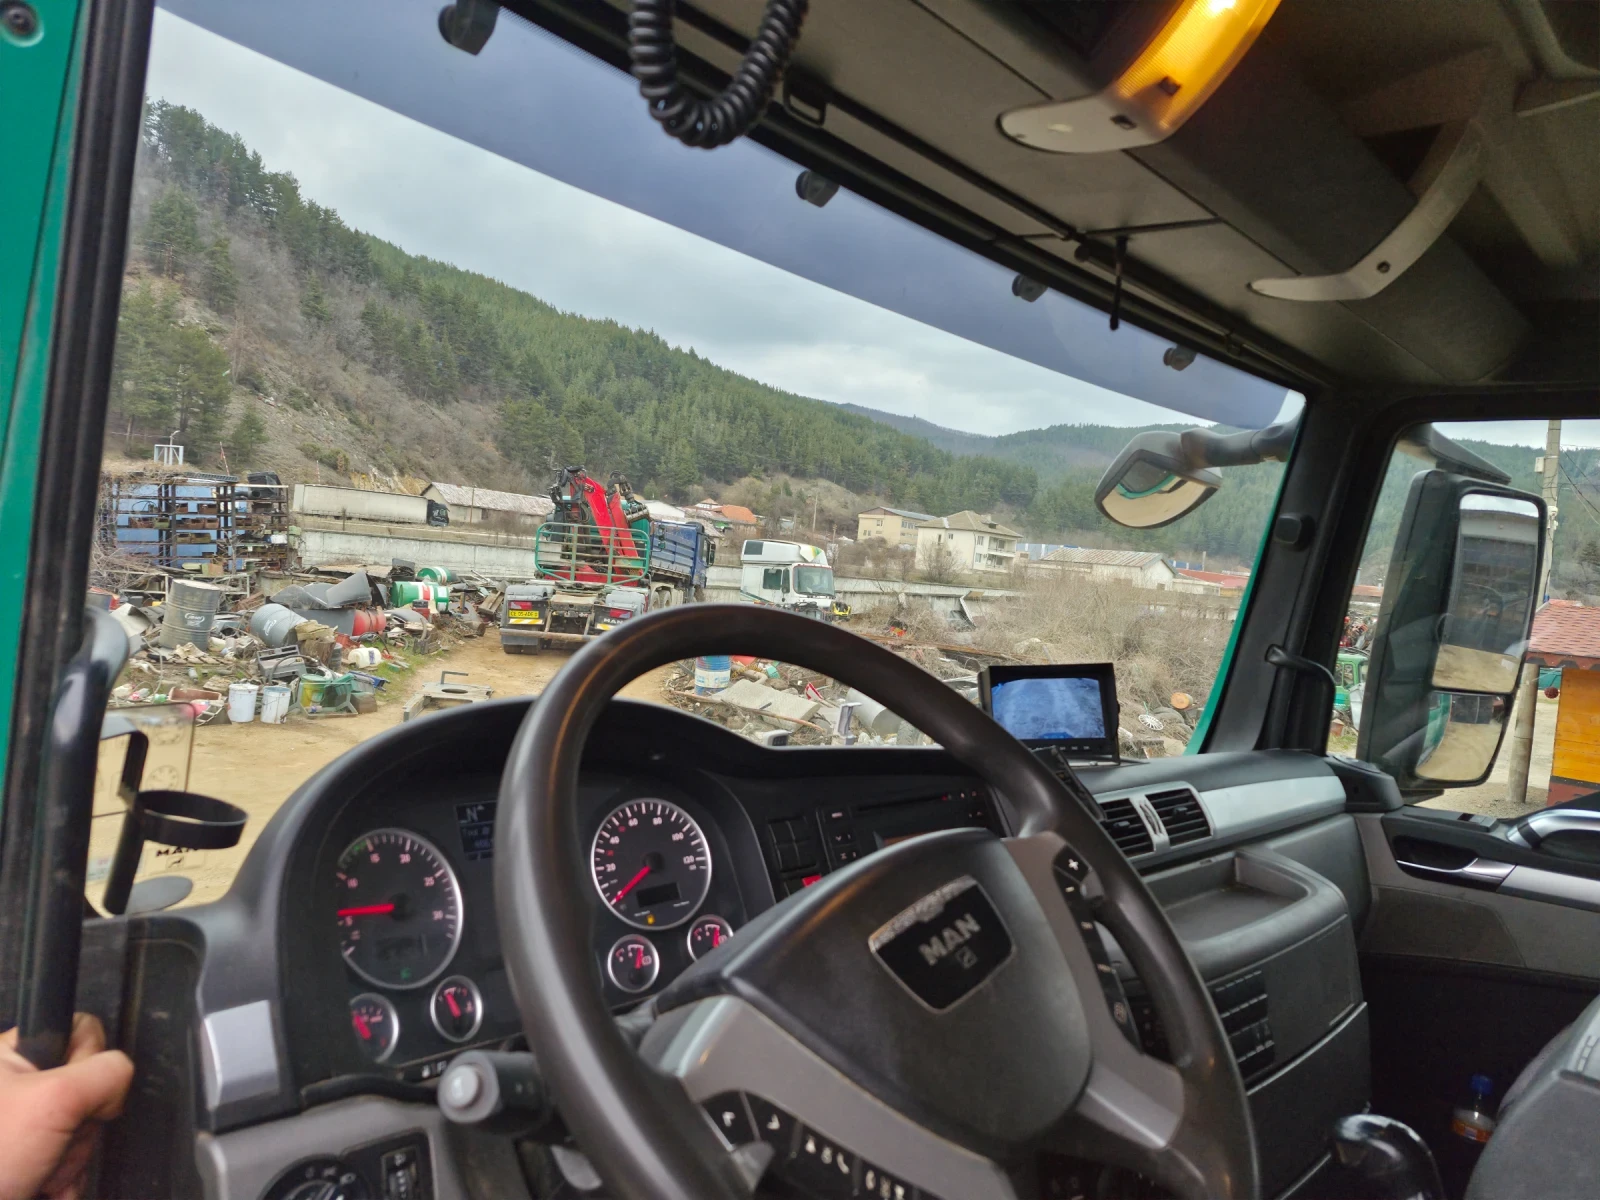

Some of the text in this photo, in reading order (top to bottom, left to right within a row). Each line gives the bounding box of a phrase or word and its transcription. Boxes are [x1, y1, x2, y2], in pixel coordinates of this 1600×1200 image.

[683, 855, 694, 864] 120
[606, 863, 615, 872] 20
[919, 913, 981, 966] MAN
